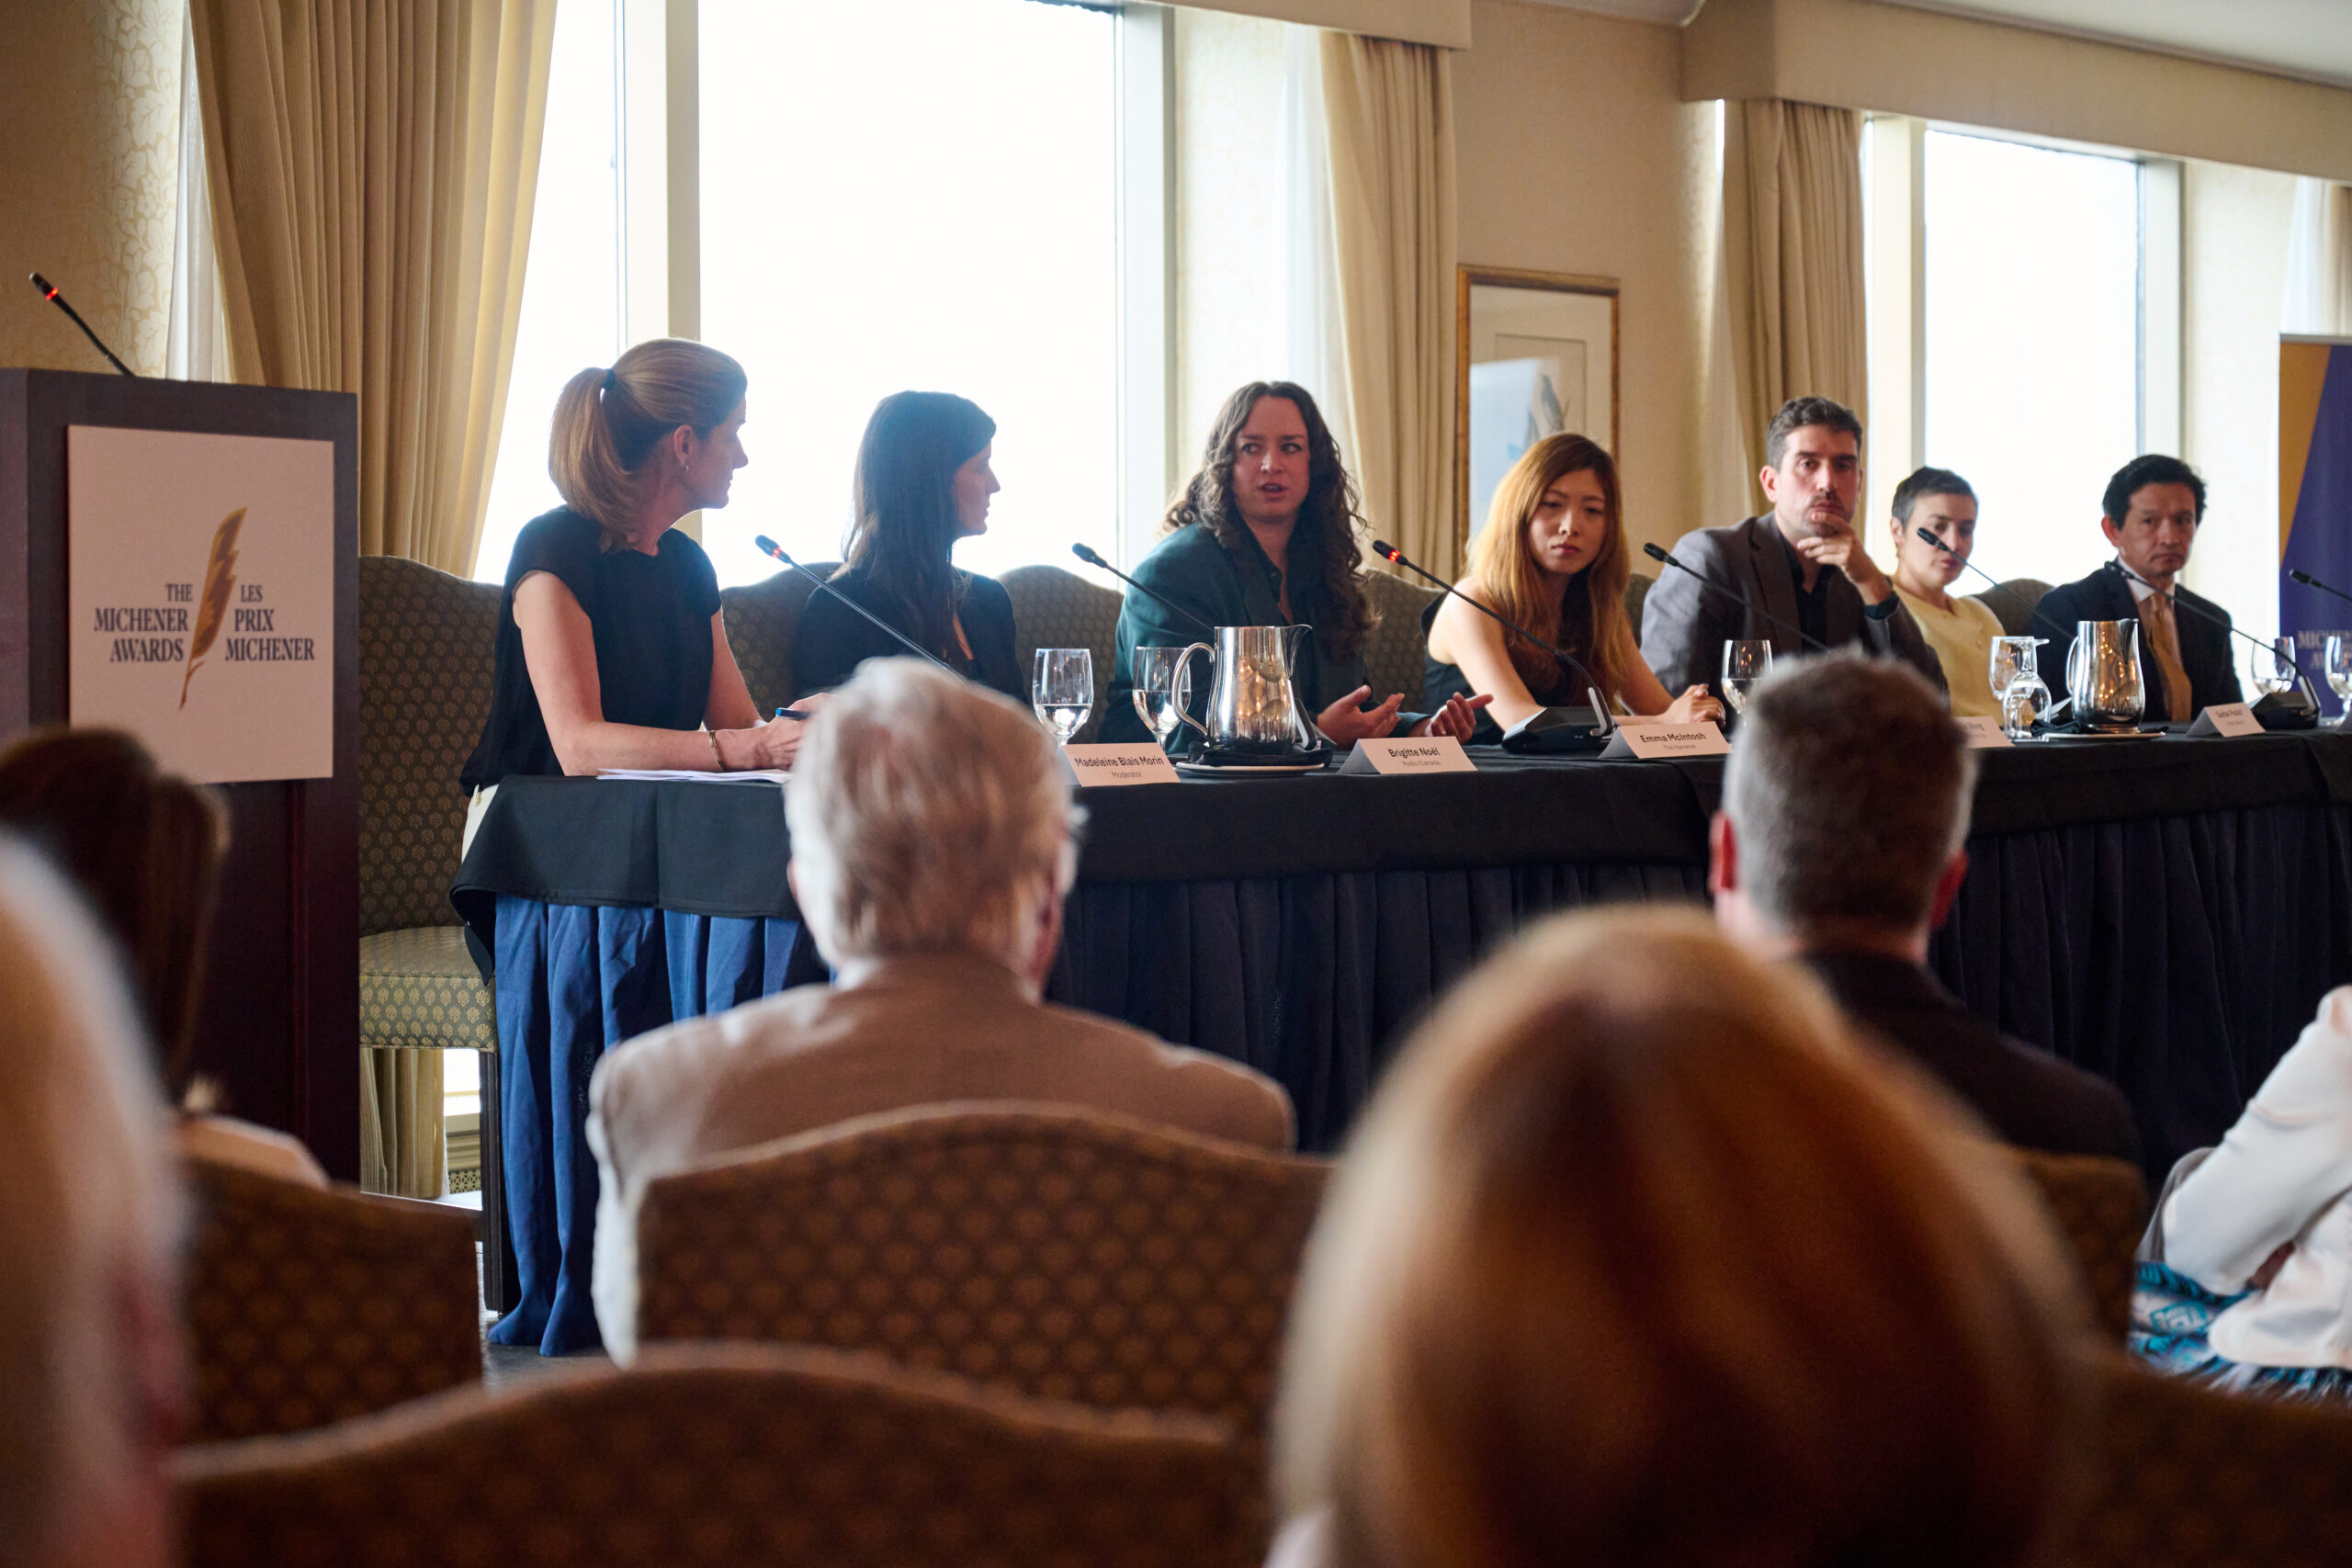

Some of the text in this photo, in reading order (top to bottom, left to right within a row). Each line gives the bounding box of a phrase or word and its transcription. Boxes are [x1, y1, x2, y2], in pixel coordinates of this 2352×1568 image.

[165, 583, 193, 602] THE
[241, 585, 263, 603] LES
[95, 608, 188, 632] MICHENER
[234, 609, 275, 632] PRIX
[109, 638, 184, 662] AWARDS
[225, 637, 315, 661] MICHENER
[1640, 732, 1707, 743] Emma McIntosh
[1074, 755, 1164, 767] Madeleine Blais Morin
[1388, 747, 1441, 759] Brigitte Noël
